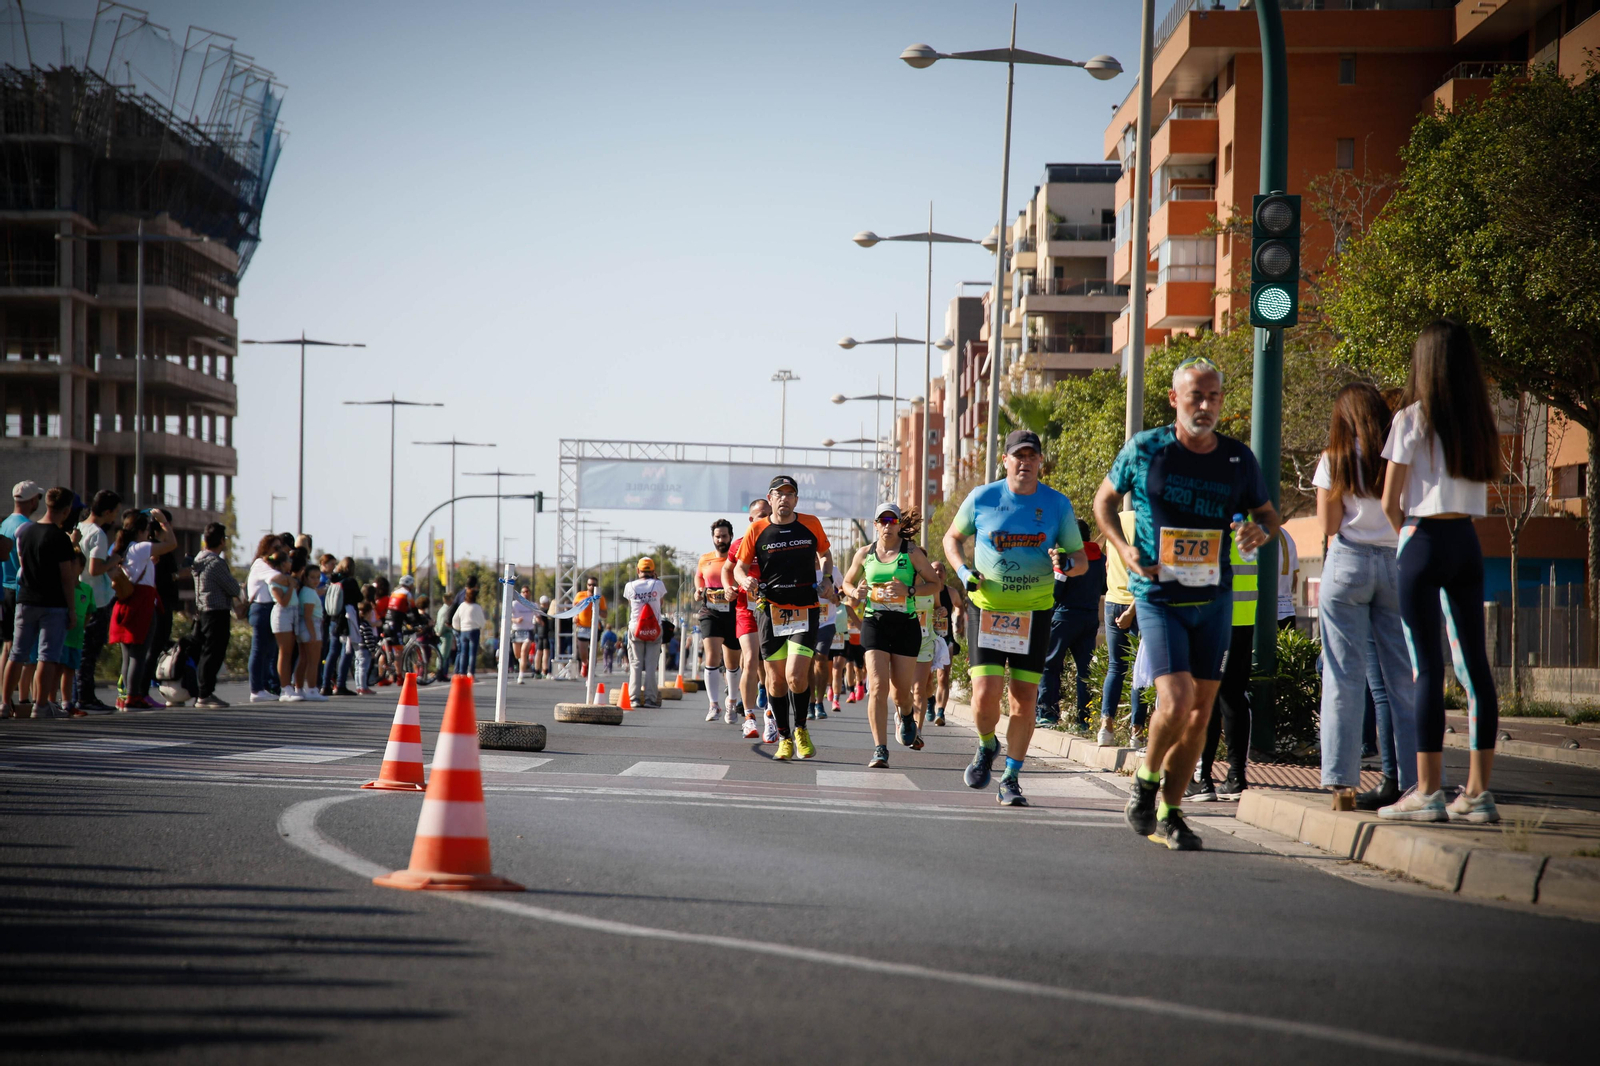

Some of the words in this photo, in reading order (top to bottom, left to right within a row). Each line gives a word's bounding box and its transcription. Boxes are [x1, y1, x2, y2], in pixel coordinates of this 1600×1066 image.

[789, 539, 812, 547] CORRE
[1174, 540, 1209, 556] 578
[1002, 574, 1039, 585] muebles
[1002, 583, 1031, 593] pepin
[991, 615, 1020, 630] 734
